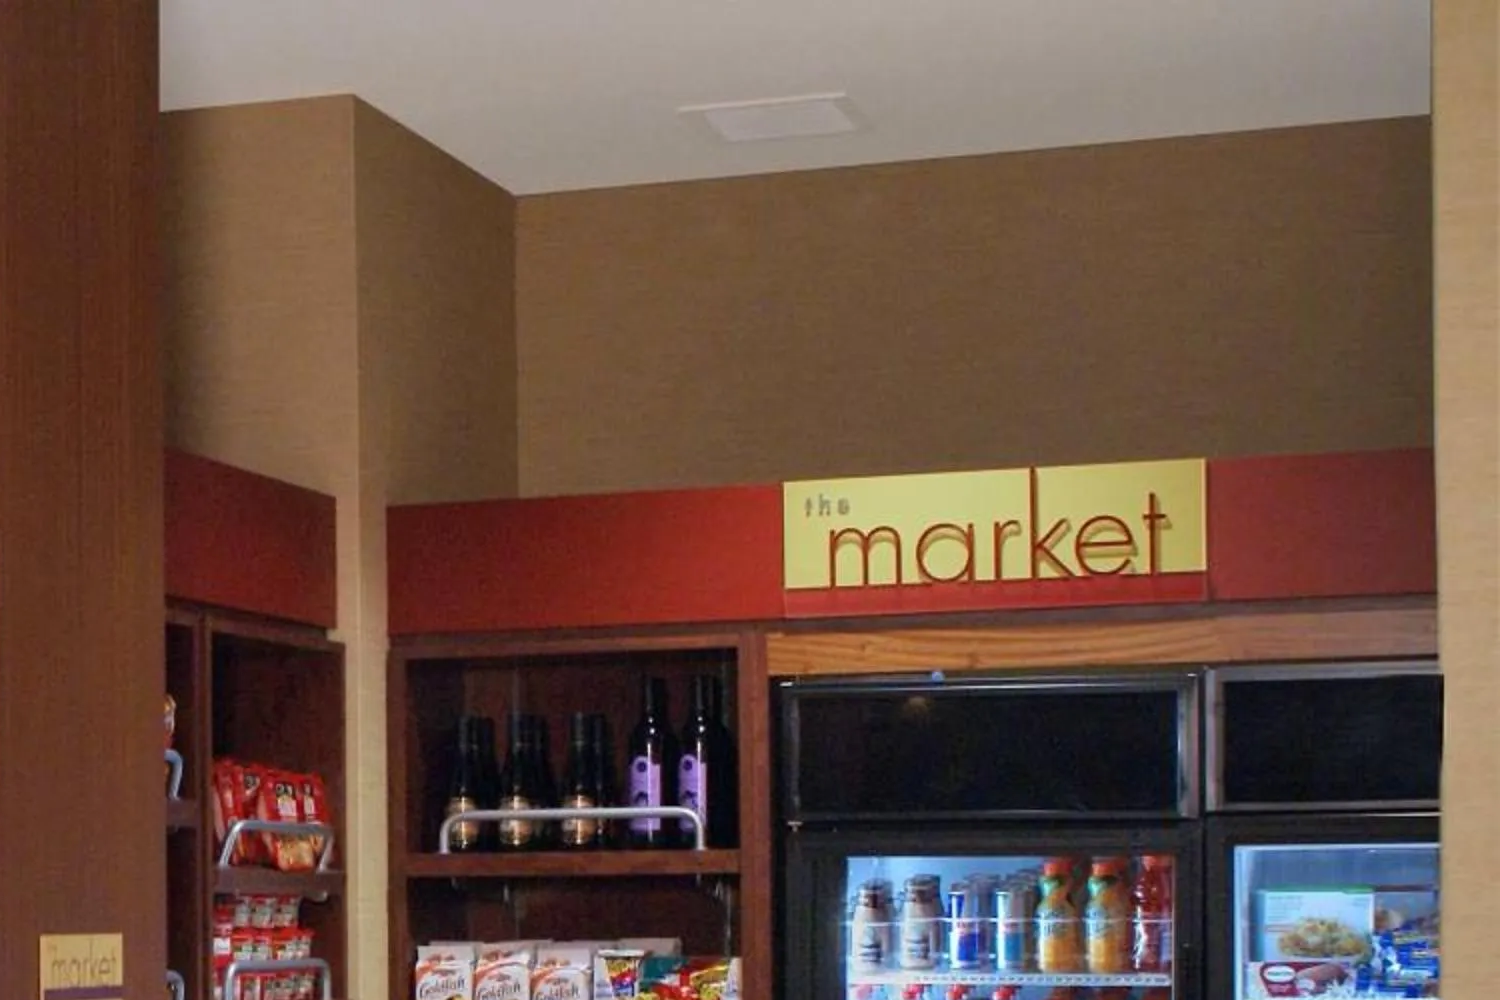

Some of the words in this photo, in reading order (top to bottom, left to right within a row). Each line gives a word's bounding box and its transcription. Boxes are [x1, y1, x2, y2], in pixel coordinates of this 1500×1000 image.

[804, 493, 851, 517] the
[828, 466, 1168, 588] market
[419, 975, 466, 1000] Goldfish
